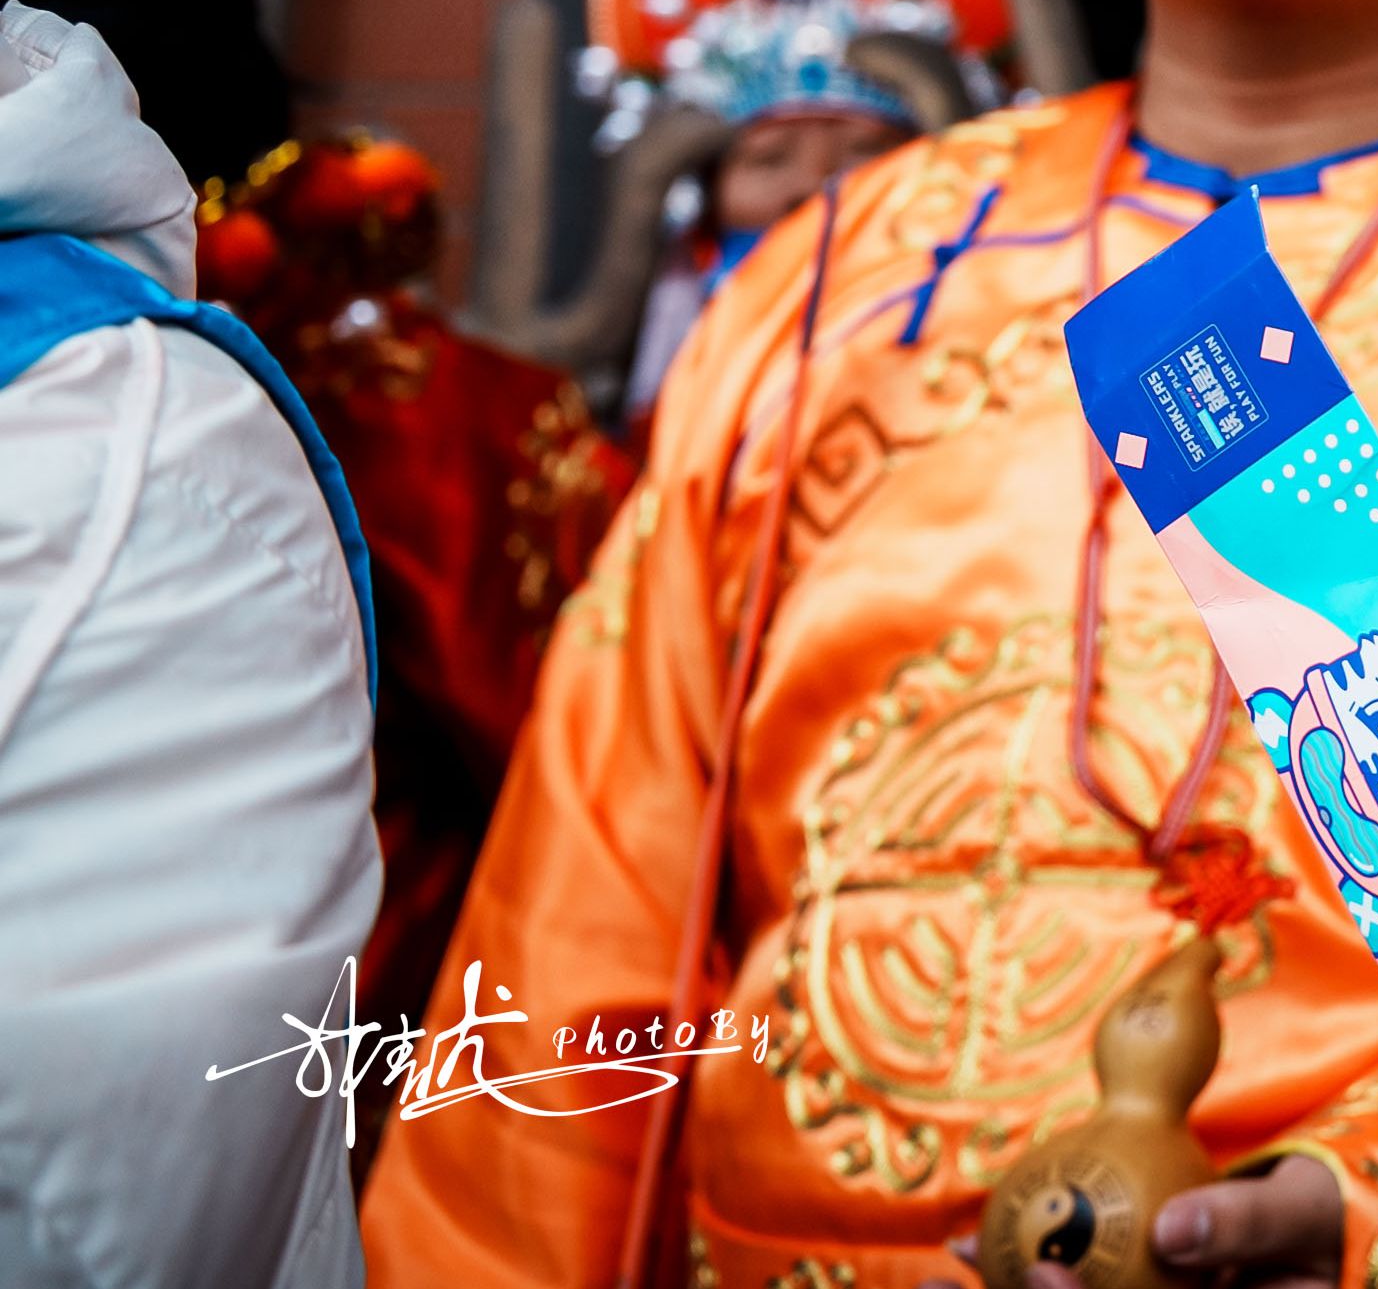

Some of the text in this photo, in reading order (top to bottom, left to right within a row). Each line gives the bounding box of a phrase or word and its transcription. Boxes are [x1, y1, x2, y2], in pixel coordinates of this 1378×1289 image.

[1147, 371, 1206, 462] SPARKLERS
[1162, 364, 1182, 389] PLAY
[1204, 335, 1260, 422] PLAY FOR FUN
